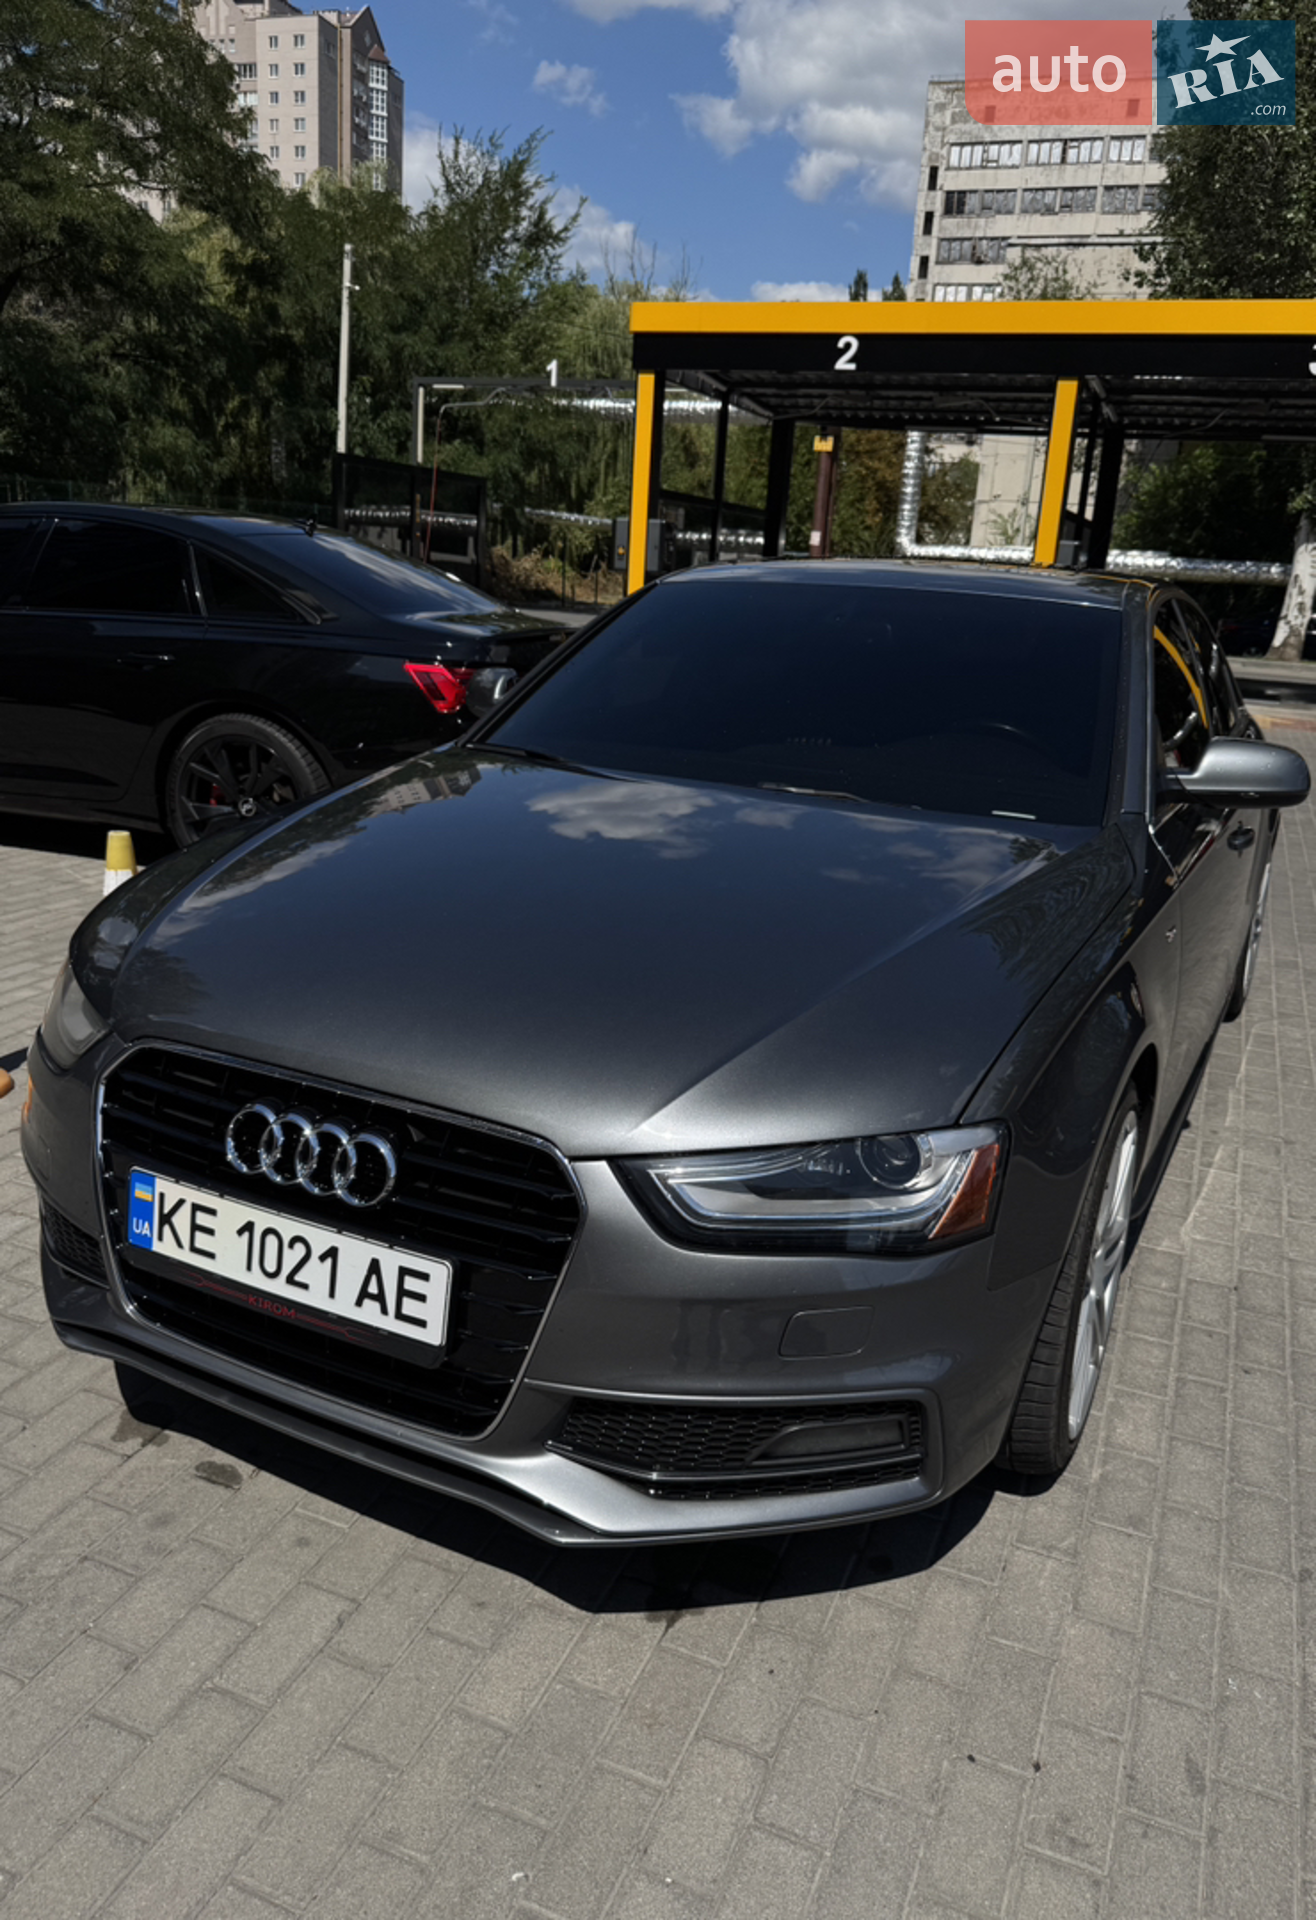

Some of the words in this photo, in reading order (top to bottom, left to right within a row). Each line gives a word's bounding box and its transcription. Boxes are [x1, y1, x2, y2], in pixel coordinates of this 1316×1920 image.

[834, 335, 859, 370] 2
[546, 359, 557, 387] 1
[132, 1216, 152, 1238] UA
[157, 1191, 218, 1260] KE
[236, 1219, 340, 1300] 1021
[354, 1256, 431, 1329] AE
